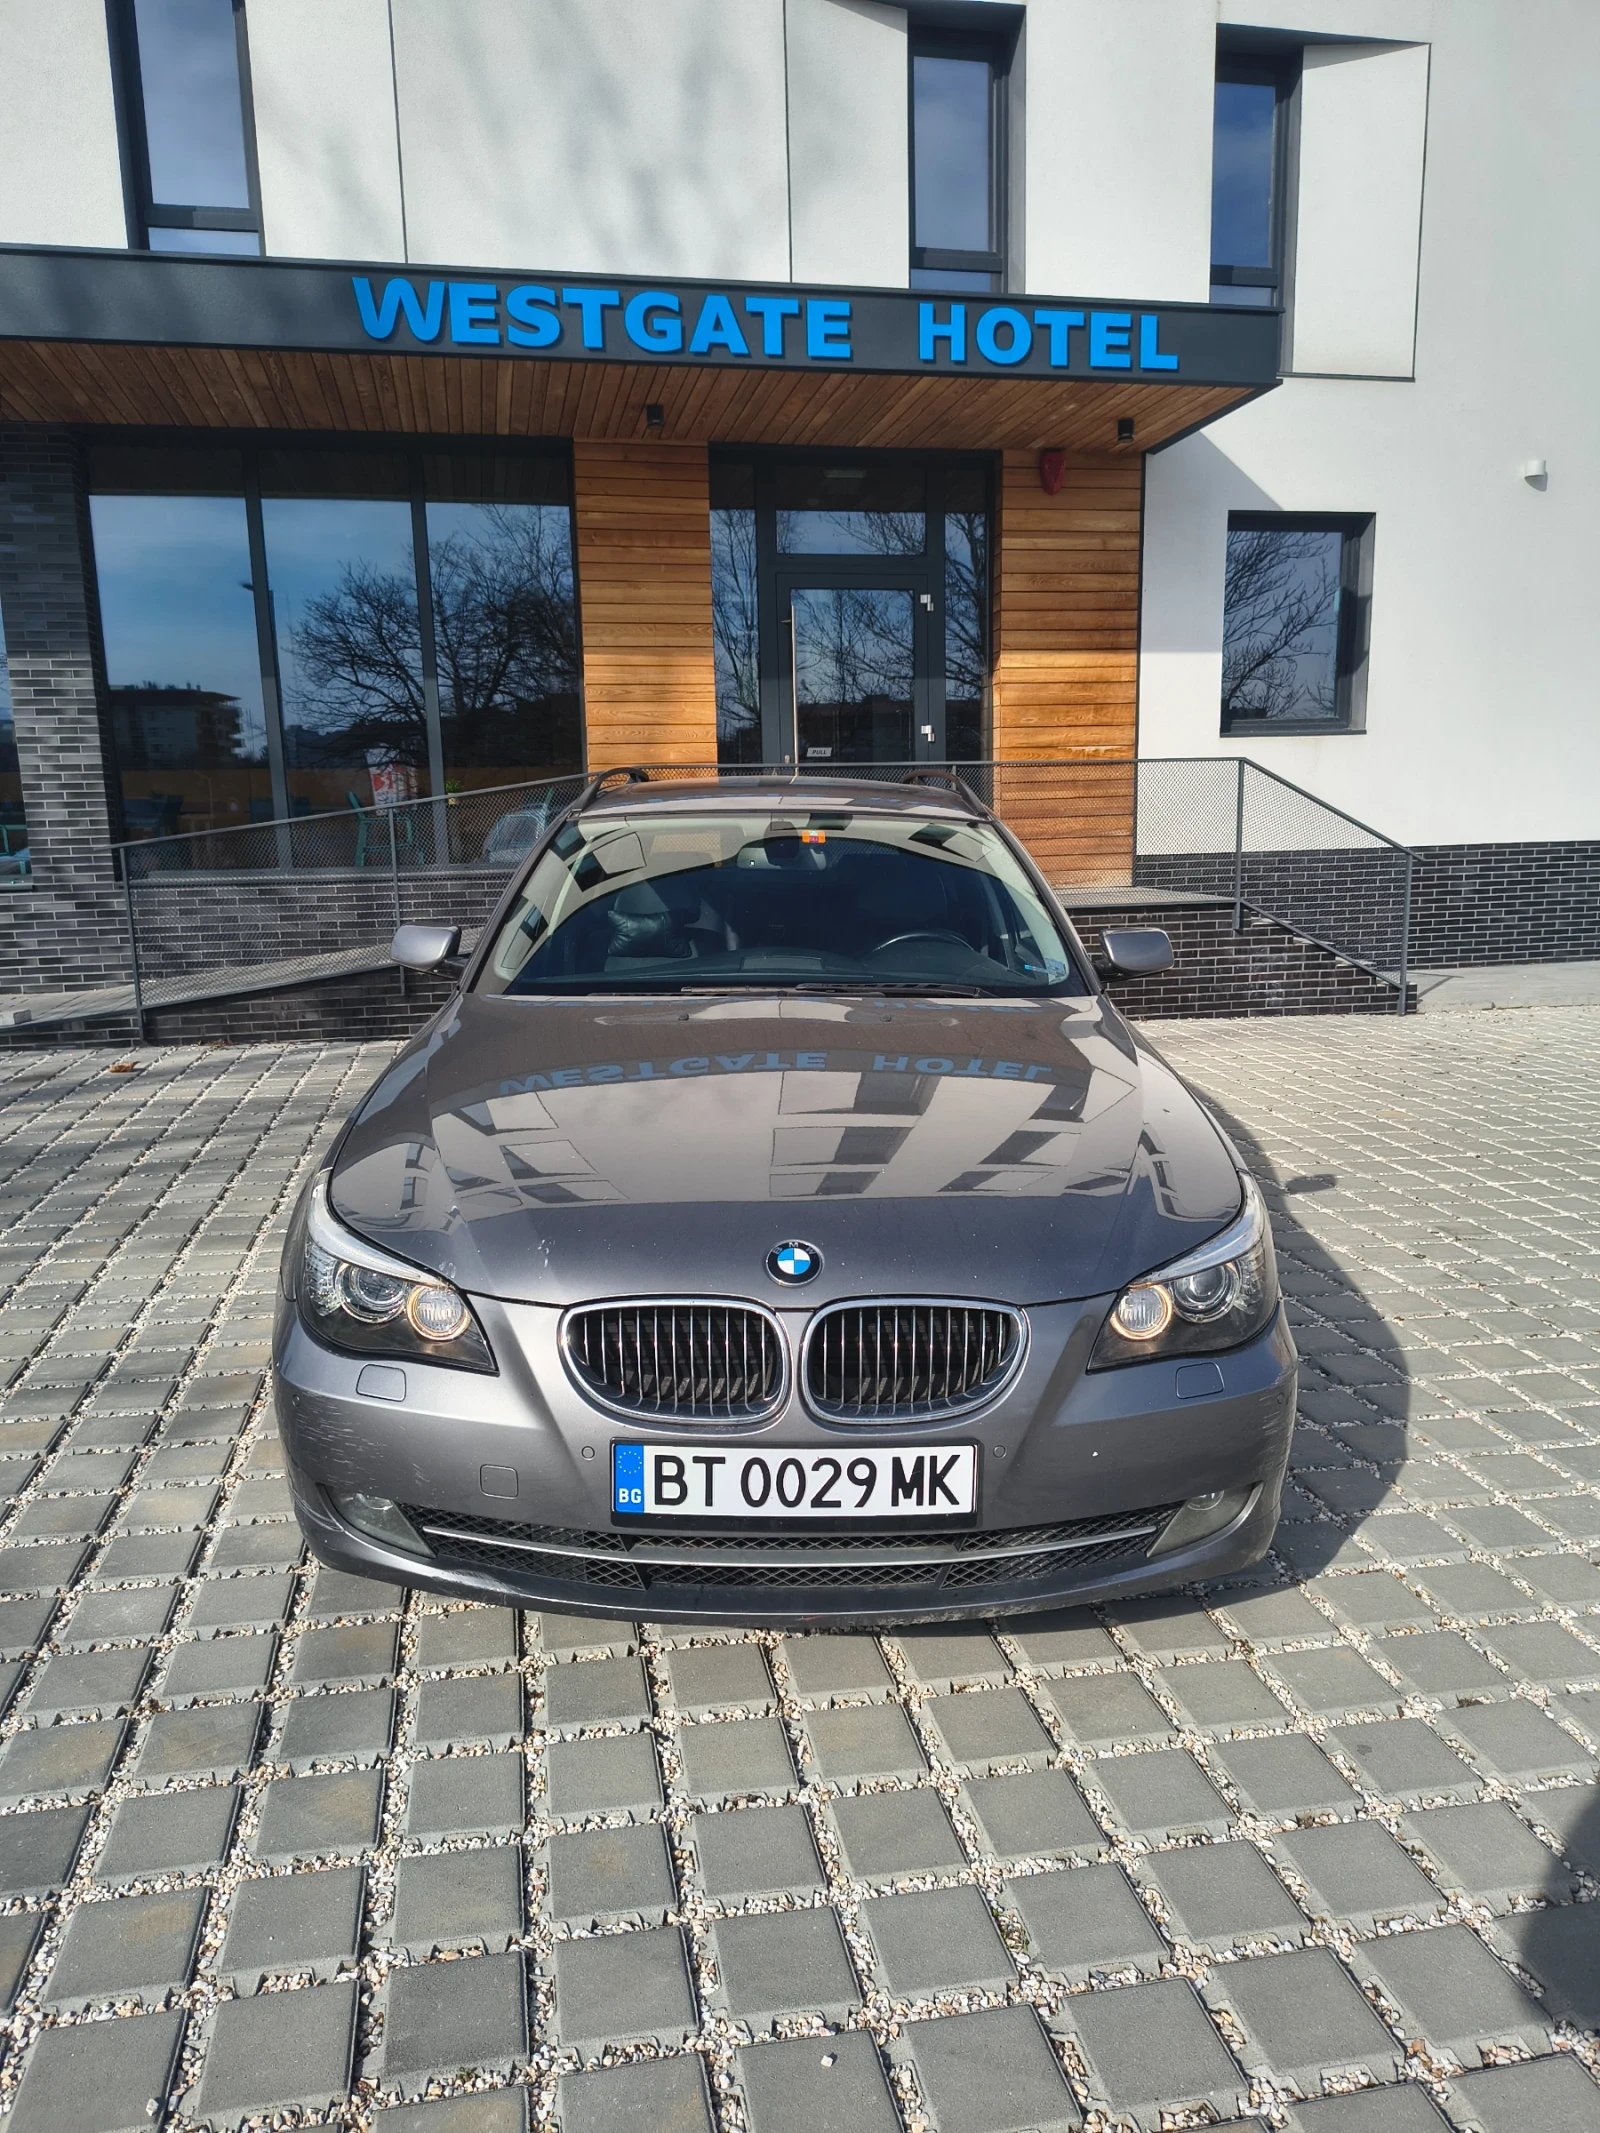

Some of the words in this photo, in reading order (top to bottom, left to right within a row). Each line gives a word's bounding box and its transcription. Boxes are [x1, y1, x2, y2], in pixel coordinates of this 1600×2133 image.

[352, 277, 850, 358] WESTGATE
[919, 302, 1178, 370] HOTEL
[773, 1242, 816, 1255] BMW
[619, 1488, 642, 1504] BG
[654, 1455, 726, 1507] BT
[740, 1457, 877, 1508] 0029
[891, 1455, 960, 1507] MK
